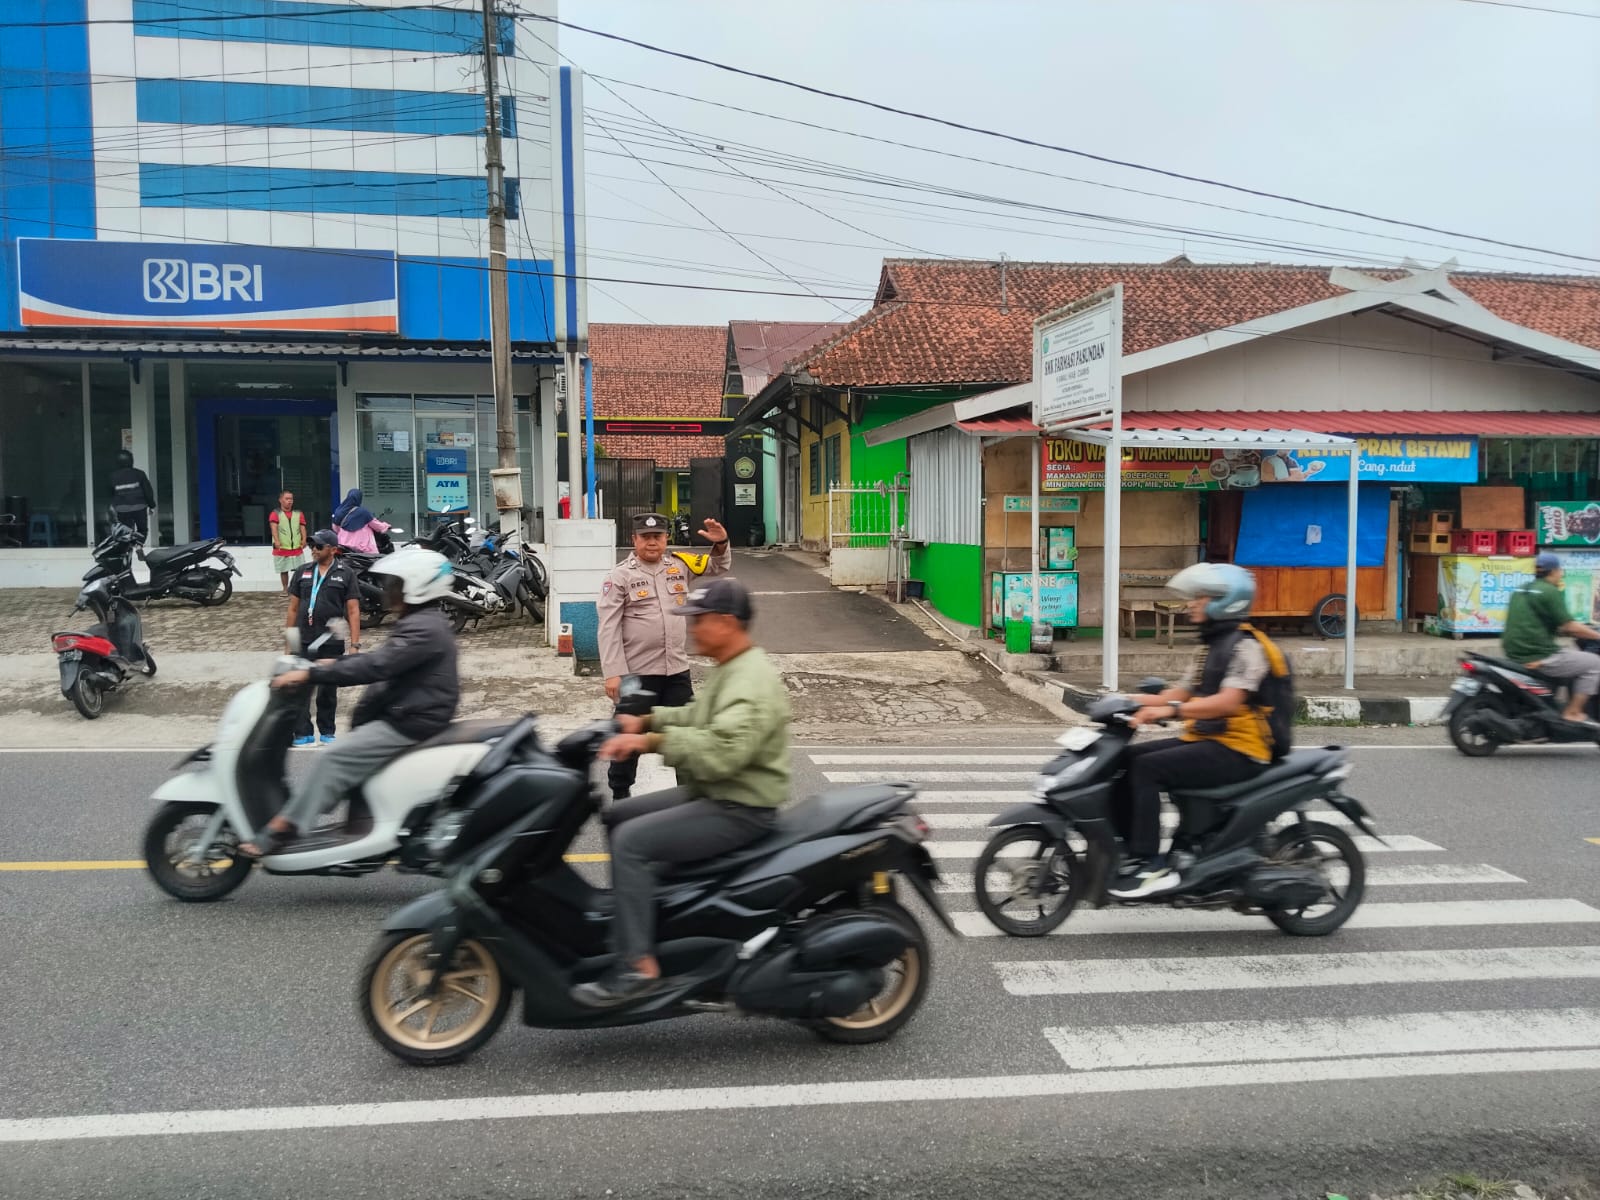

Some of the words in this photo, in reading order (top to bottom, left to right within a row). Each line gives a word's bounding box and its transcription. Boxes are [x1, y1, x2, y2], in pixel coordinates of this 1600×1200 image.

[191, 262, 263, 302] BRI
[1044, 359, 1054, 376] SMK
[1054, 349, 1076, 373] FARMASI
[1075, 341, 1105, 367] PASUNDAN
[1047, 440, 1082, 461] TOKO
[1140, 447, 1211, 461] WARMINDO
[1406, 440, 1471, 458] BETAWI
[436, 480, 459, 488] ATM
[1020, 500, 1051, 508] NNE
[1553, 510, 1562, 536] MILO
[631, 581, 649, 589] DEDI
[1023, 576, 1056, 587] NNE
[1480, 571, 1495, 588] Es
[1480, 590, 1511, 604] crea
